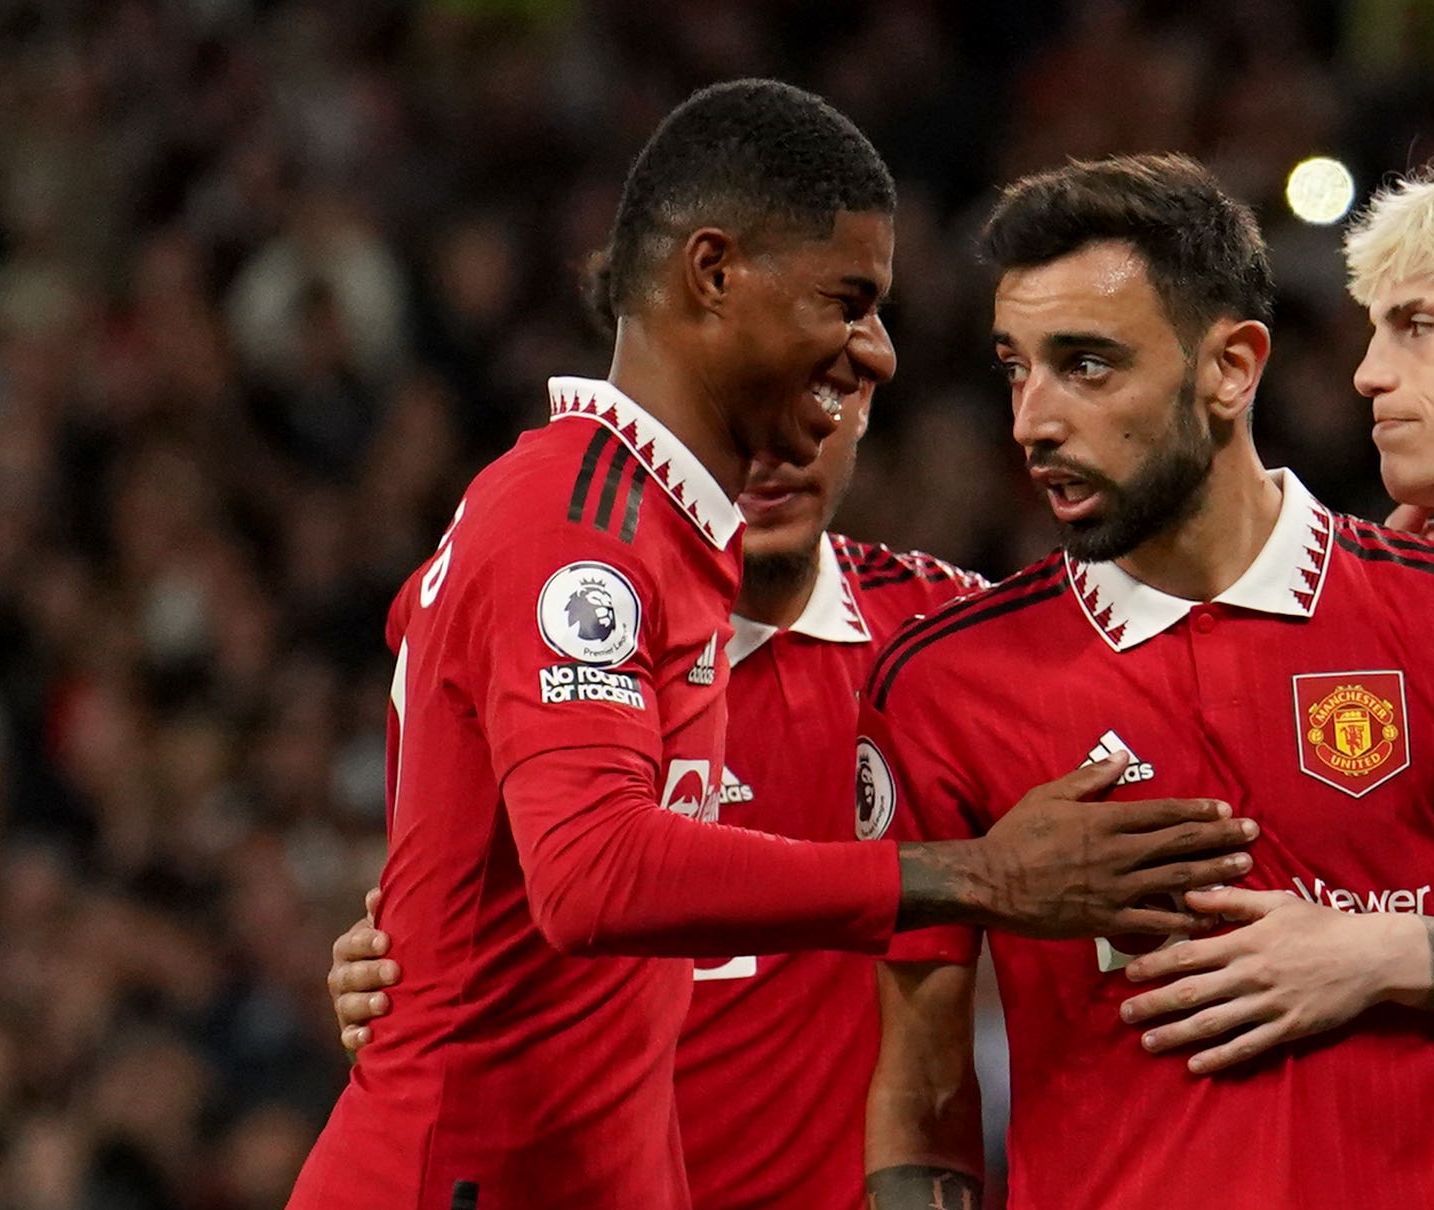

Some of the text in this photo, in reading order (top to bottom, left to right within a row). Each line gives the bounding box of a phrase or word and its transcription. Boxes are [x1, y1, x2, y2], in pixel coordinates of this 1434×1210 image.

[539, 665, 633, 689] No room
[542, 684, 646, 711] for racism
[1315, 691, 1387, 722] MANCHESTER
[1330, 752, 1381, 770] UNITED
[719, 783, 754, 804] das
